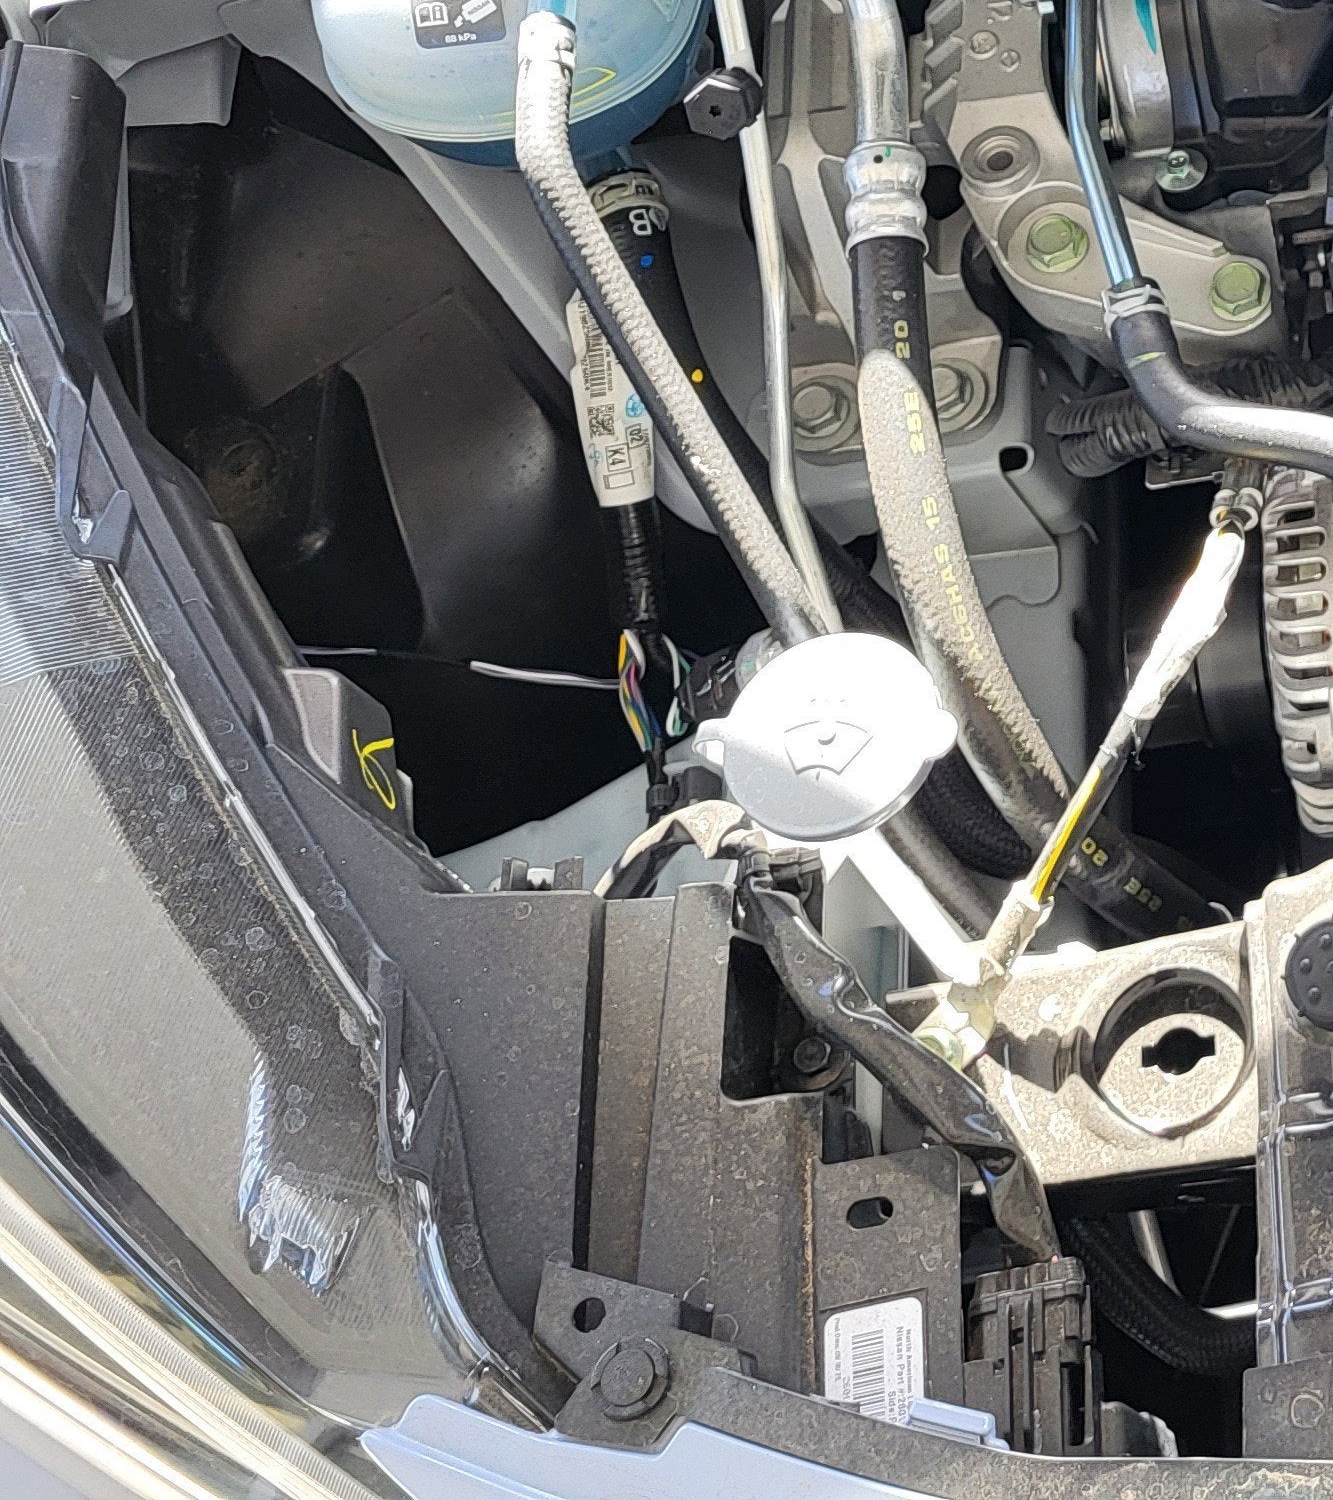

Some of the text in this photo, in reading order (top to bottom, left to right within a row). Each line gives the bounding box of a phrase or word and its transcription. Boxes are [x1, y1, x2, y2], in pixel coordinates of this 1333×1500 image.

[608, 448, 626, 466] K4
[896, 1325, 904, 1361] Nissan
[896, 1363, 905, 1385] Part
